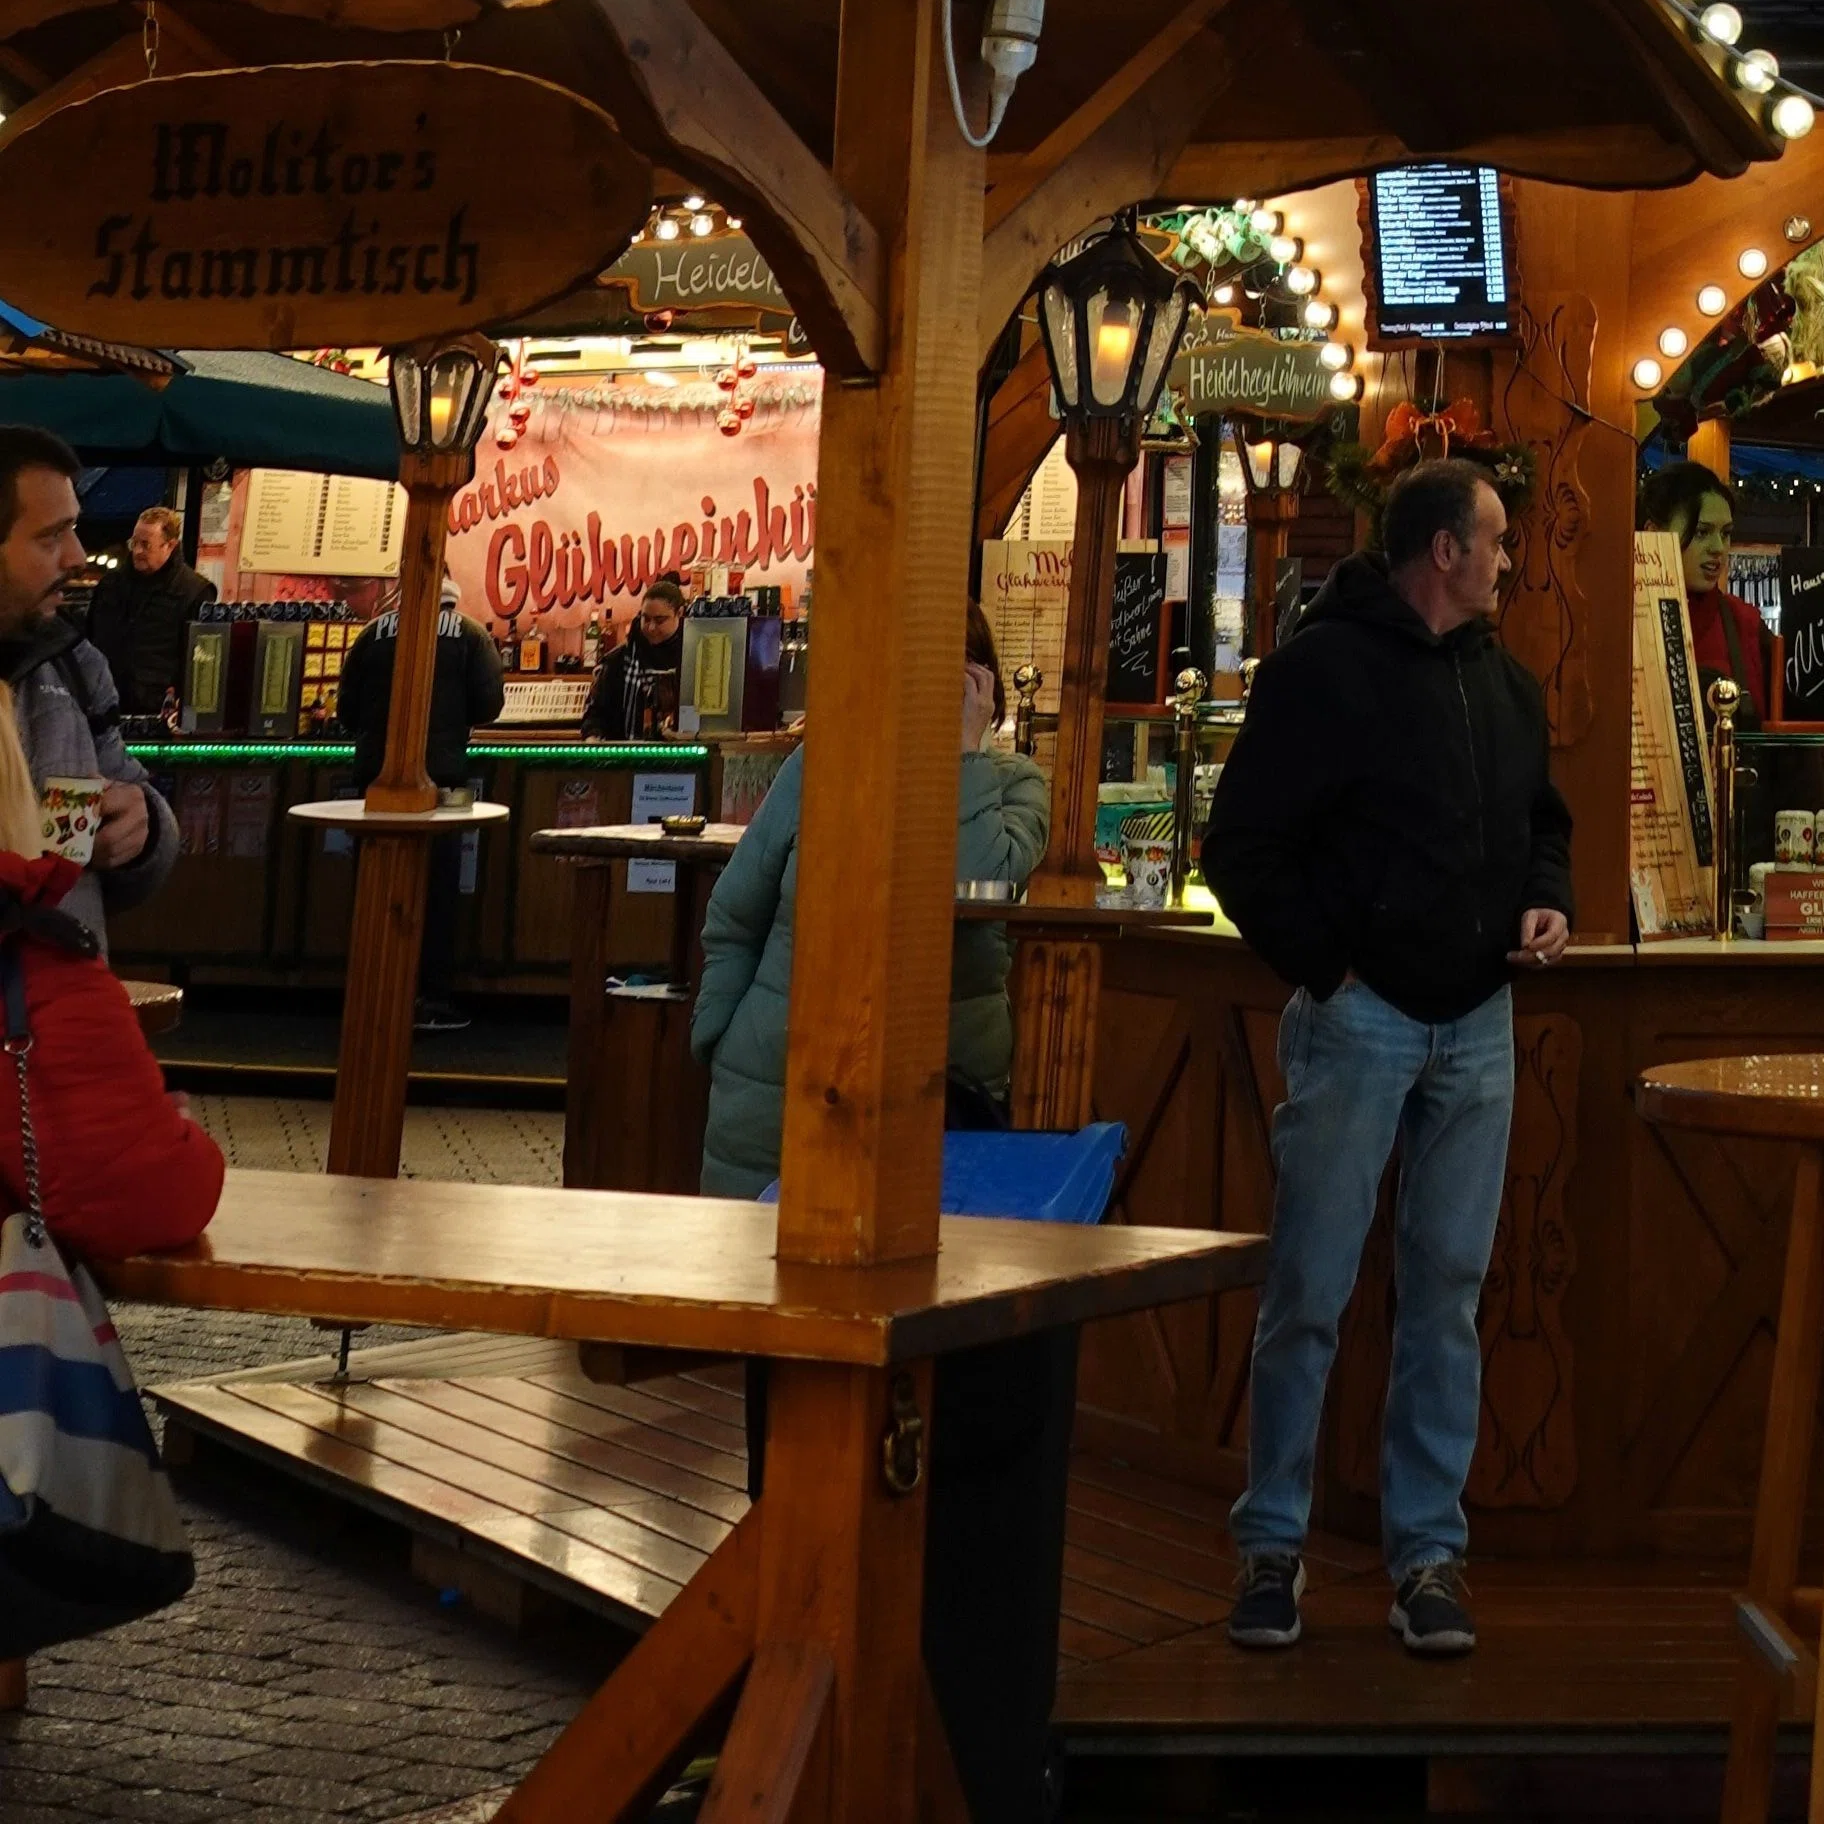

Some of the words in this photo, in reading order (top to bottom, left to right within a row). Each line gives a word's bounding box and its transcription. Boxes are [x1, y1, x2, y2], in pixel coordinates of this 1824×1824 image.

[149, 112, 437, 202] Molitor's
[87, 202, 480, 306] Stammtisch
[375, 609, 463, 641] PEOR
